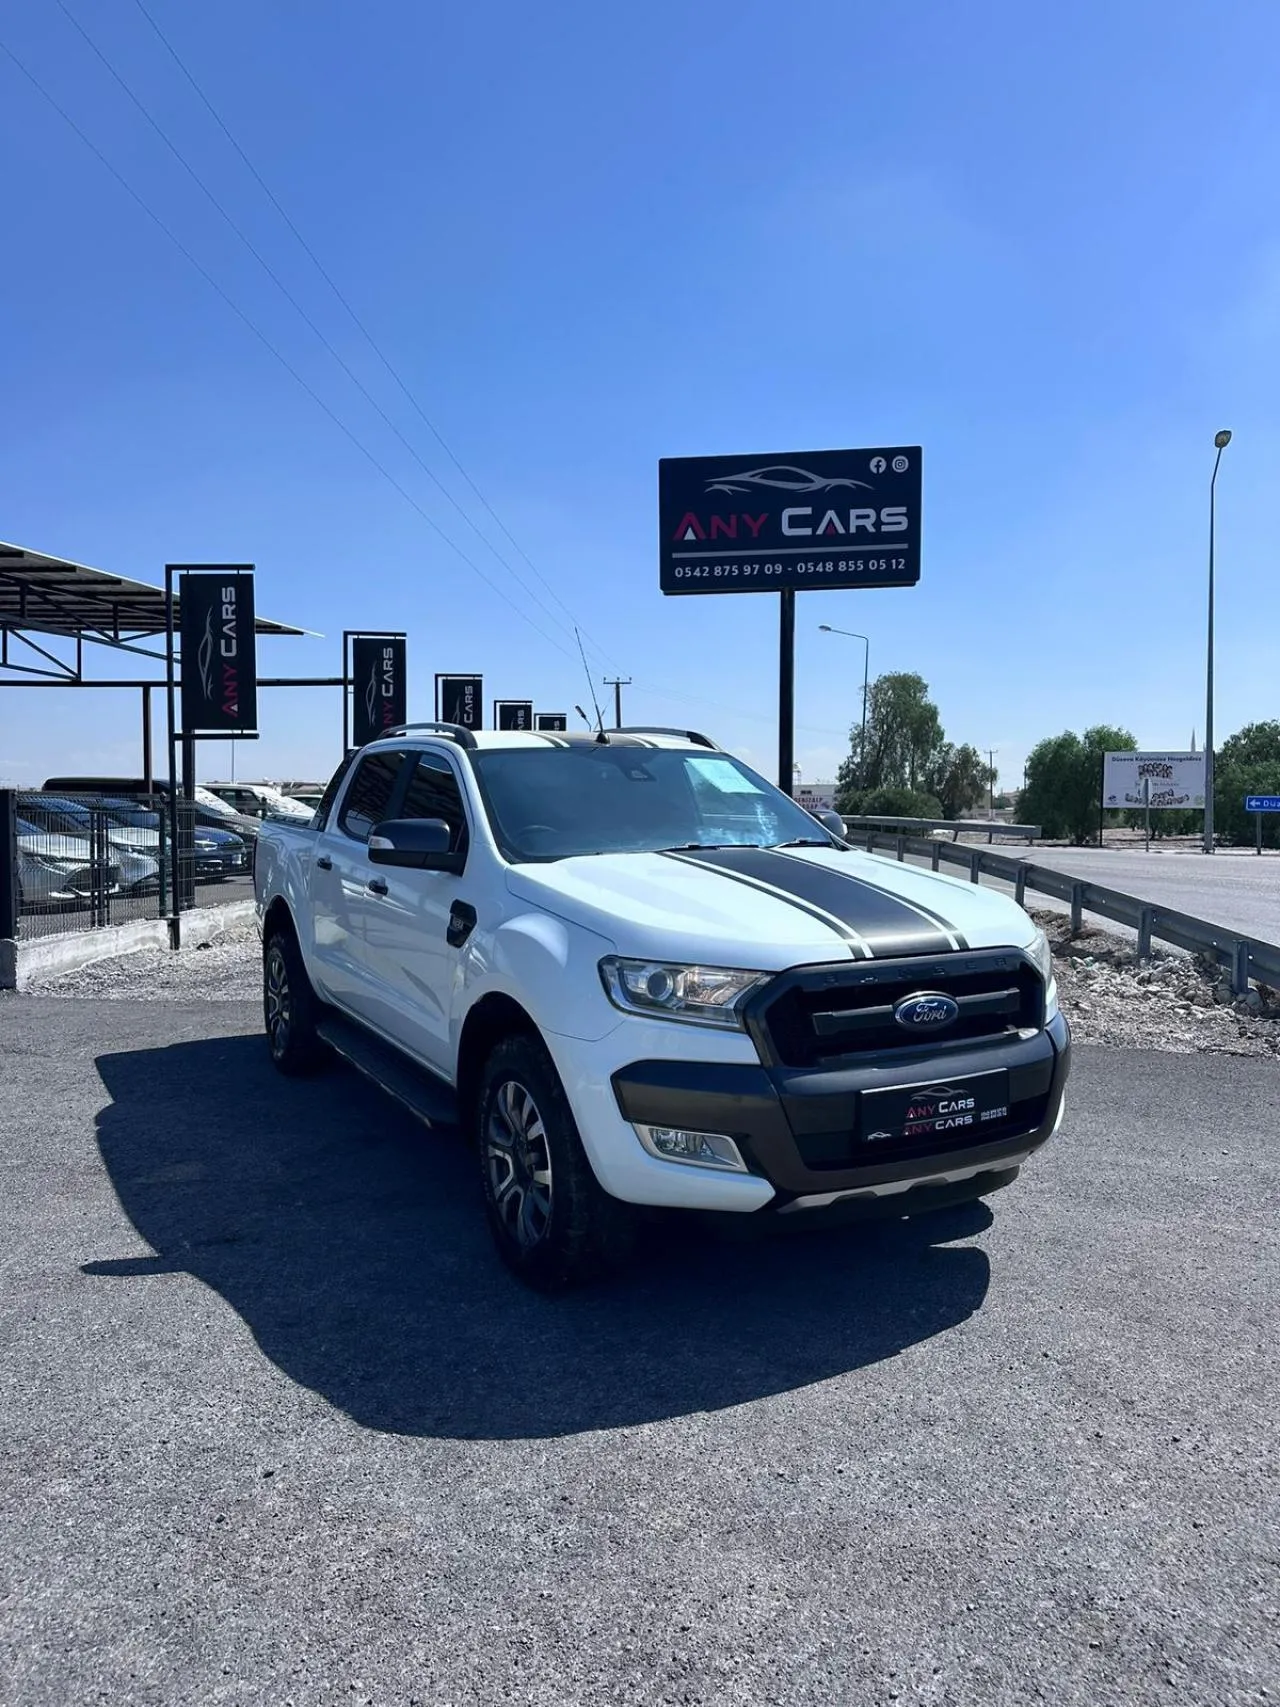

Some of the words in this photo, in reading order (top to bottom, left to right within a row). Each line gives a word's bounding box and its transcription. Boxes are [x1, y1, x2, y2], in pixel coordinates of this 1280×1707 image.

[672, 511, 769, 541] ANY
[781, 506, 909, 537] CARS
[674, 566, 711, 578] 0542
[714, 565, 739, 577] 875
[743, 564, 760, 575] 97
[764, 563, 783, 575] 09
[797, 561, 834, 574] 0548
[838, 560, 864, 572] 855
[868, 559, 887, 570] 05
[891, 558, 906, 570] 12
[220, 586, 238, 658] CARS
[382, 647, 394, 697] CARS
[221, 664, 239, 718] ANY
[463, 685, 474, 724] CARS
[383, 701, 394, 727] NY
[913, 1002, 947, 1023] Ford
[906, 1104, 936, 1118] ANY
[938, 1098, 975, 1113] CARS
[935, 1115, 973, 1130] CARS
